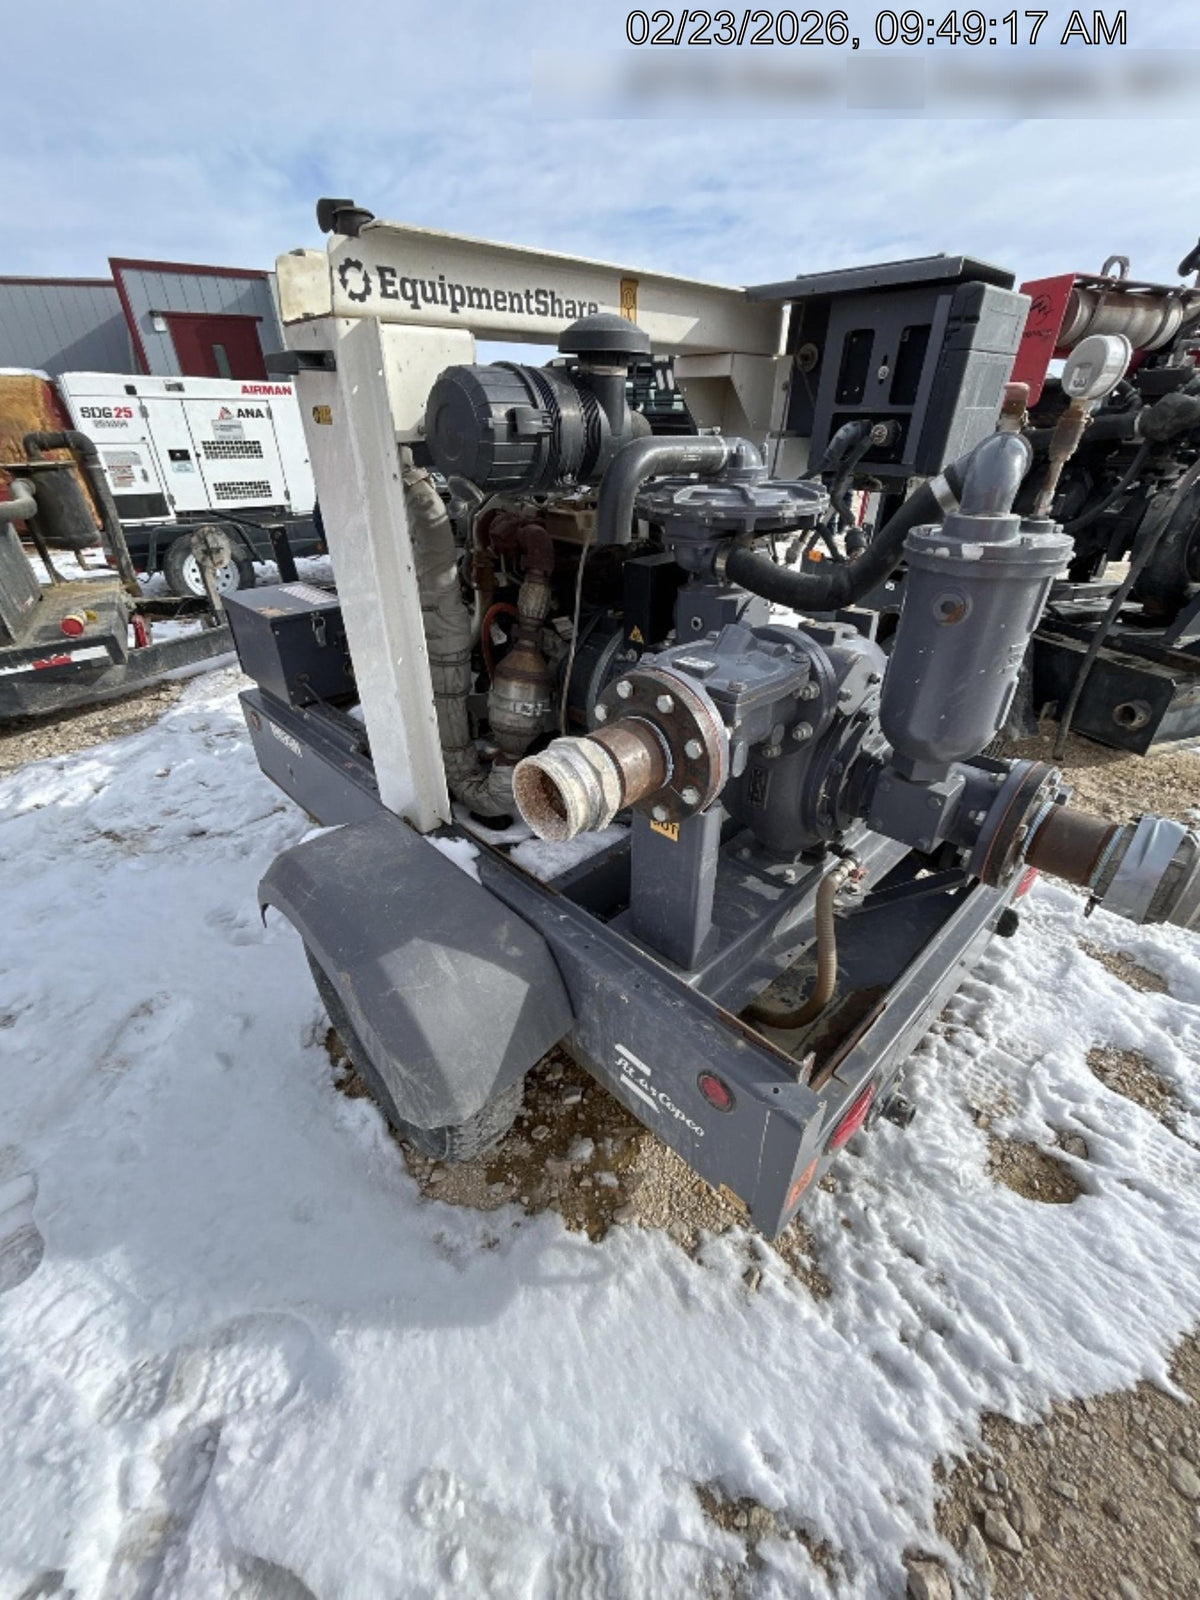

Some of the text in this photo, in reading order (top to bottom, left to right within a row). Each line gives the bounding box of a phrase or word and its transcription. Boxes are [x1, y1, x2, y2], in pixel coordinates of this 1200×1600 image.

[376, 265, 599, 318] EquipmentShare
[241, 384, 292, 396] AIRMAN
[237, 407, 265, 419] ANA
